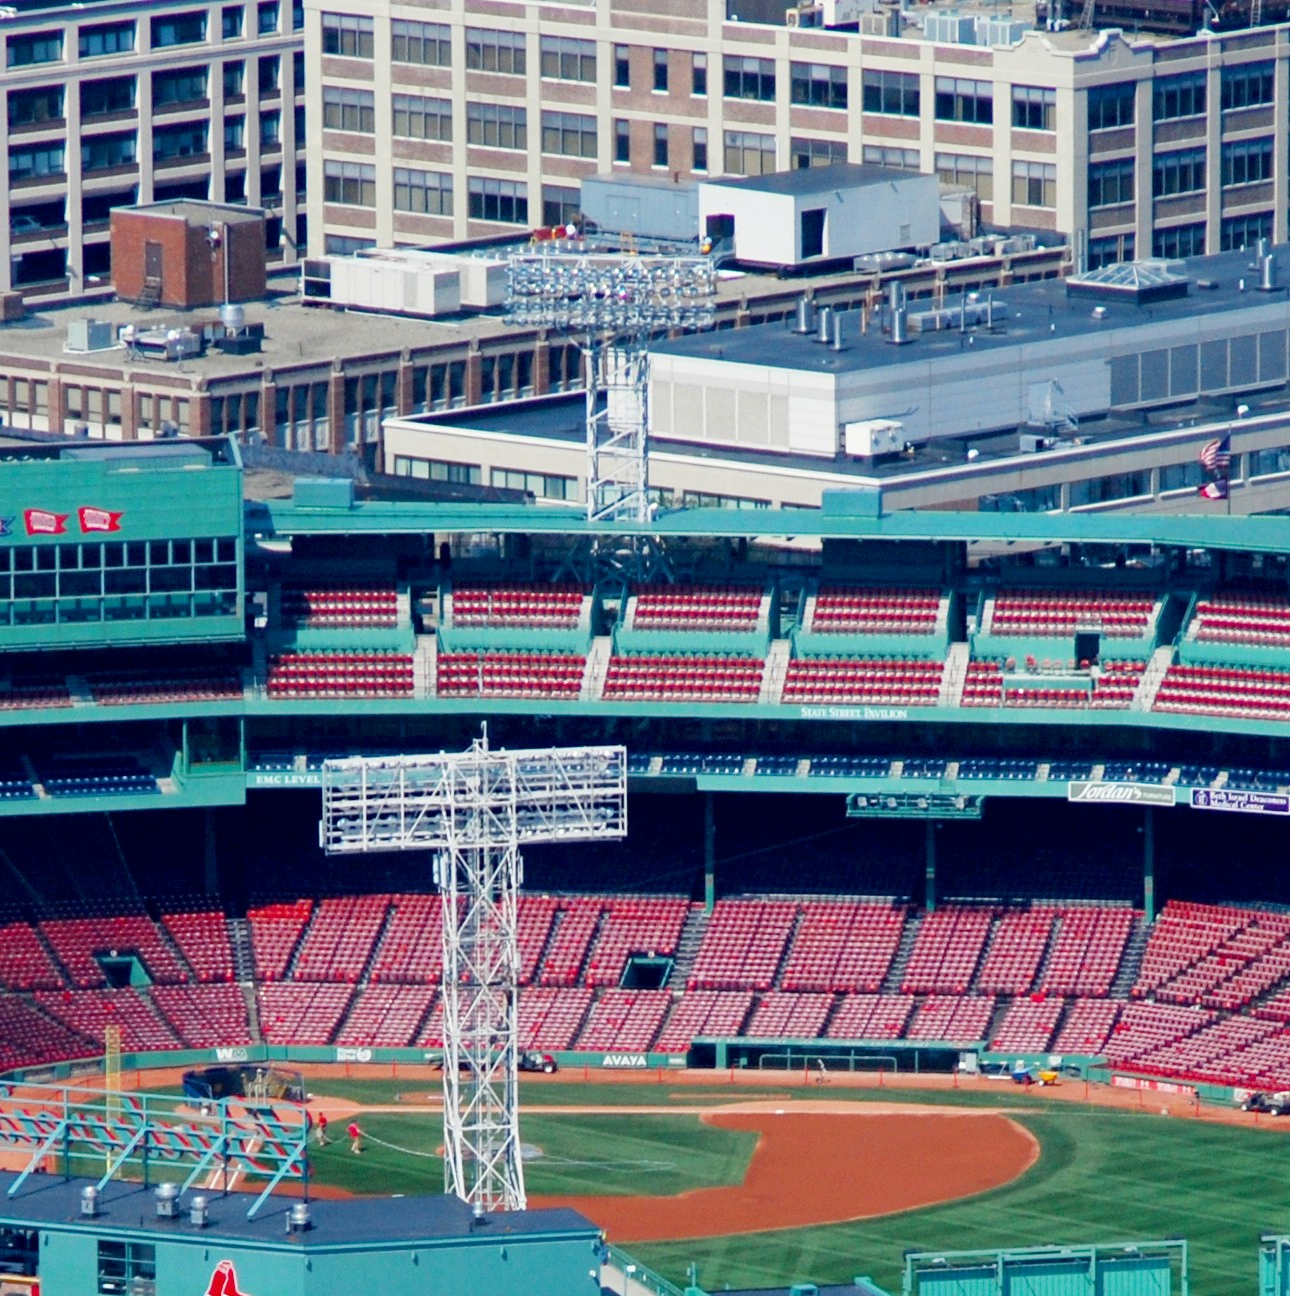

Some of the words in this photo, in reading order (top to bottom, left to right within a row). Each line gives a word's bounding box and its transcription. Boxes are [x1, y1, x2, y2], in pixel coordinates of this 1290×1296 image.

[256, 775, 282, 785] EMC
[284, 775, 321, 784] LEVEL
[1076, 782, 1142, 800] Jordan's
[602, 1055, 648, 1067] AVAYA
